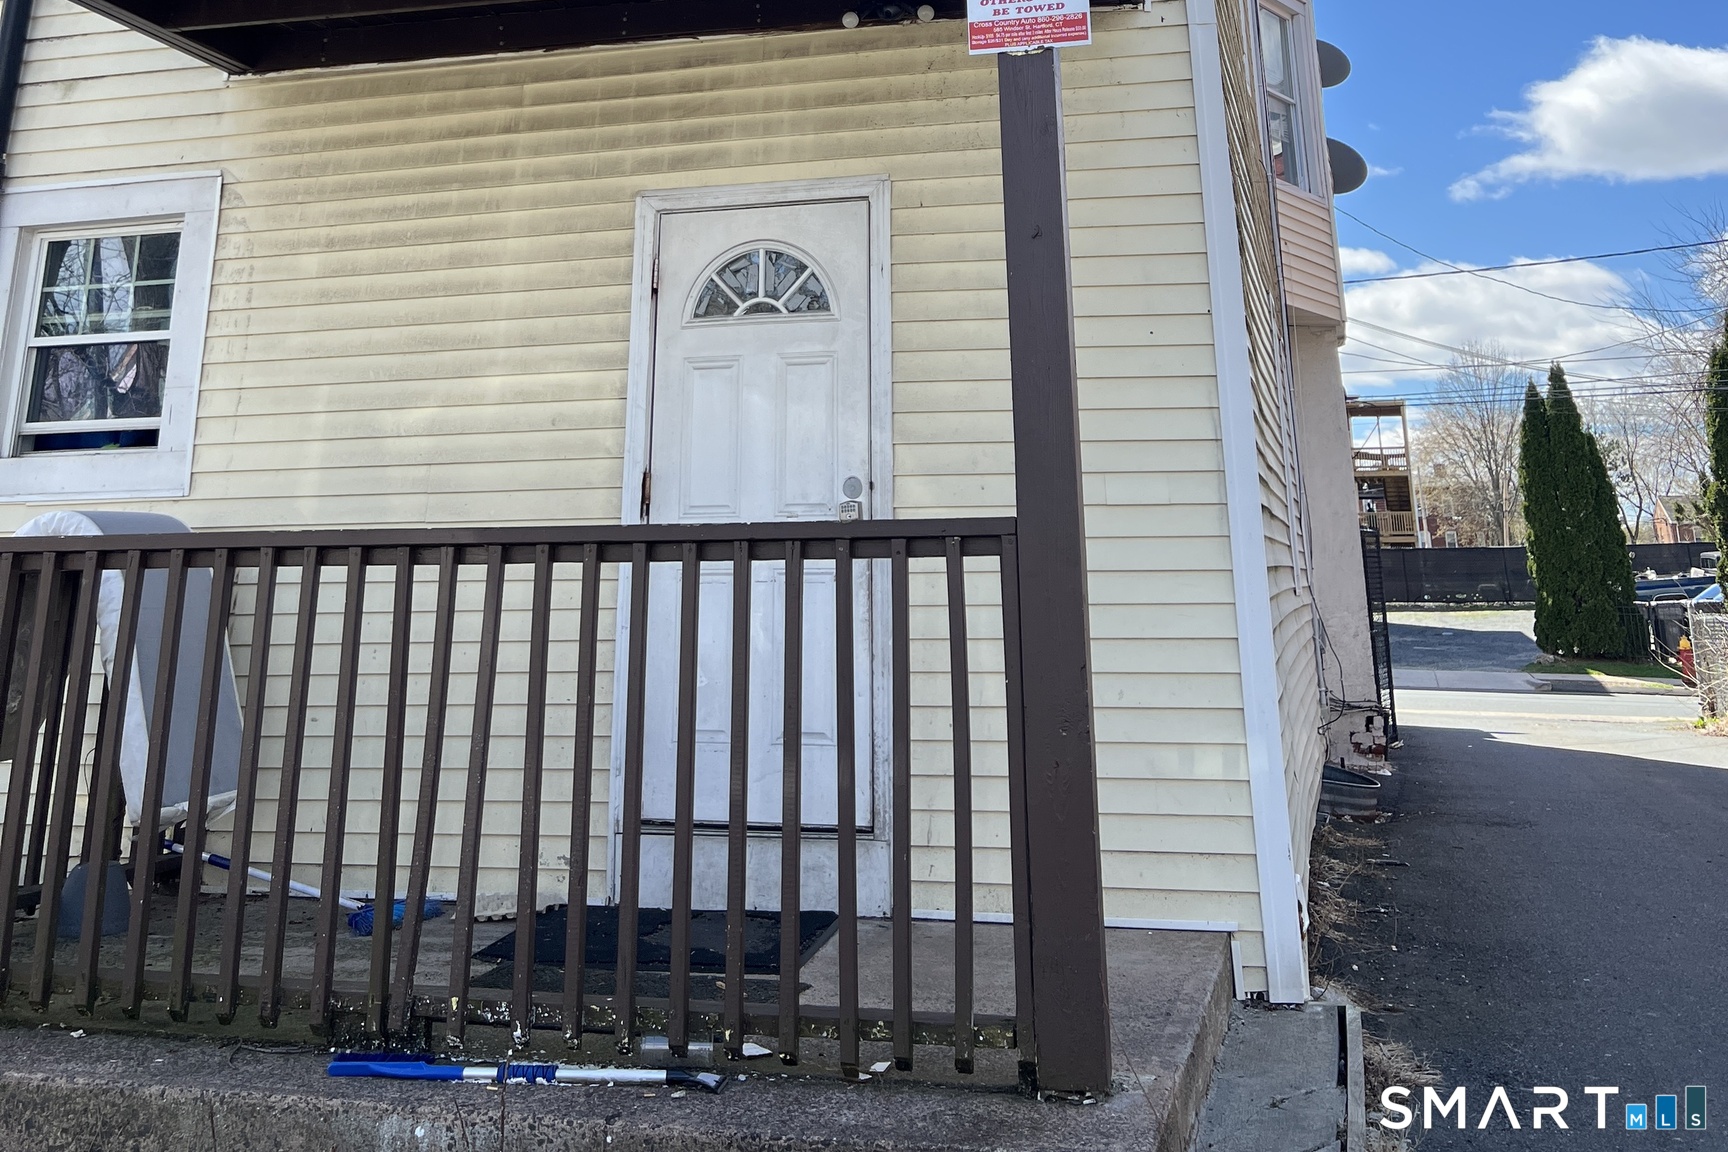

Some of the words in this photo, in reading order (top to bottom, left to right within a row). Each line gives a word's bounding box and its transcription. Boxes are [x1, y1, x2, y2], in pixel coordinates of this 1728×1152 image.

[992, 8, 1010, 16] BE
[1016, 3, 1065, 14] TOWED
[994, 19, 1020, 27] Country
